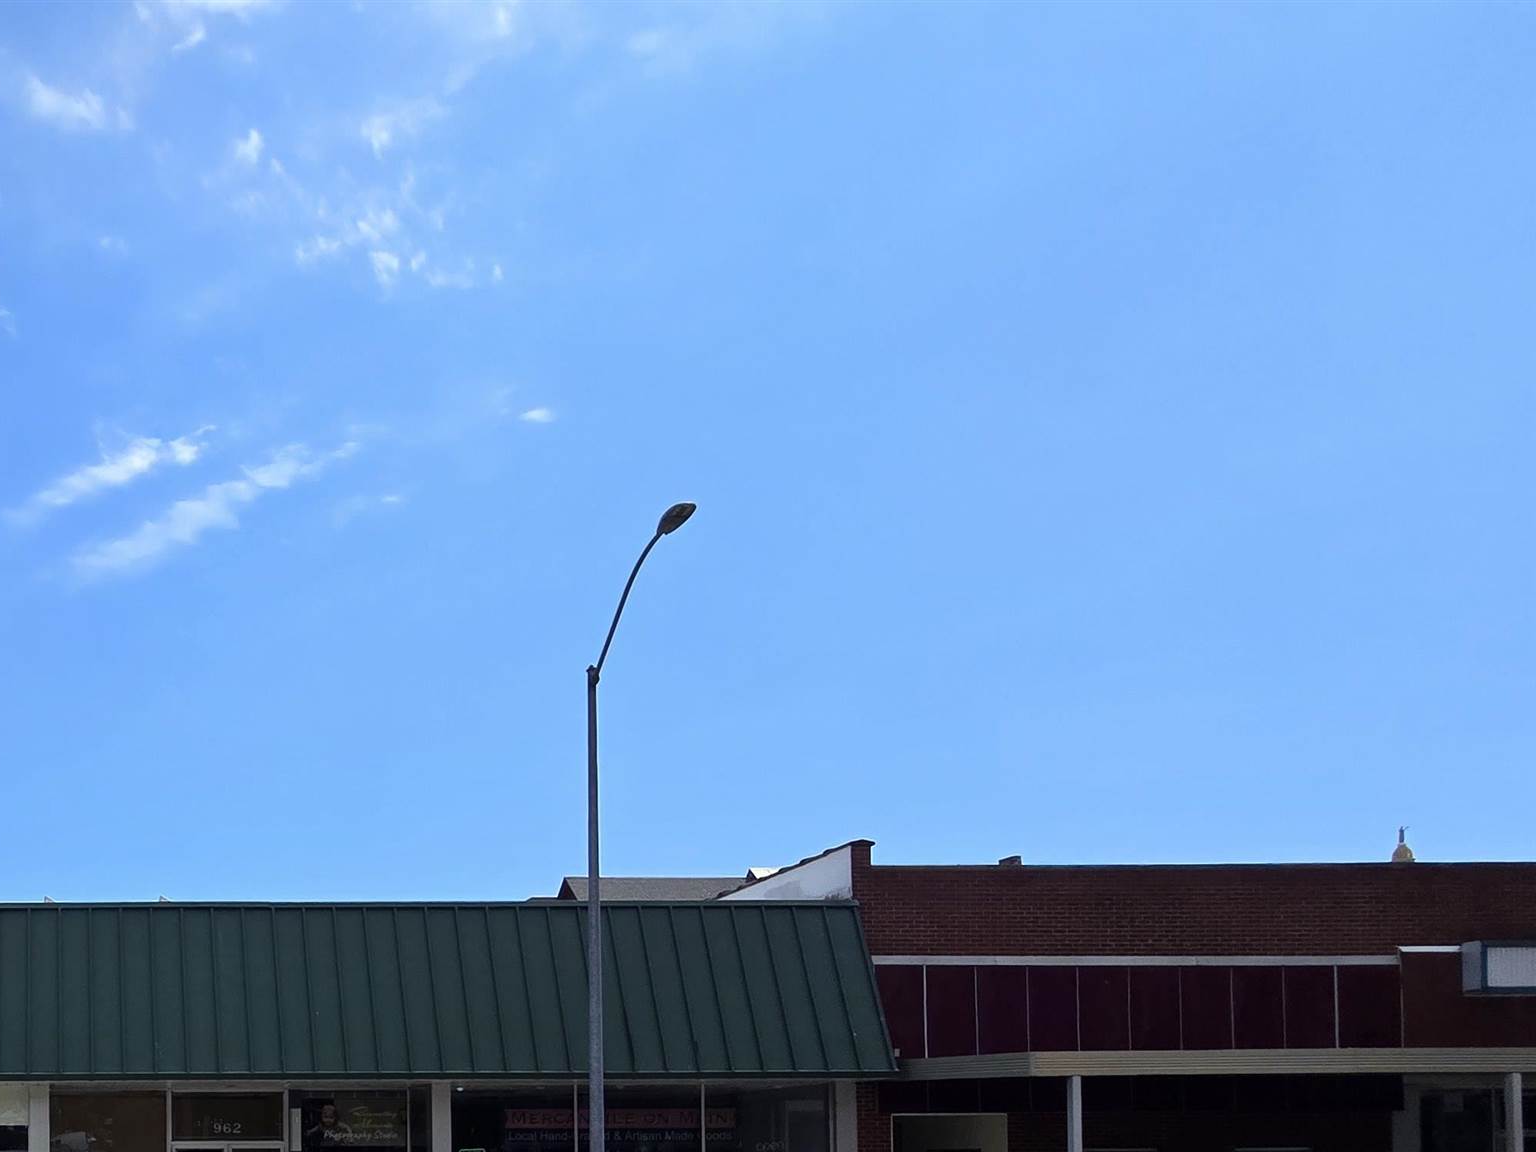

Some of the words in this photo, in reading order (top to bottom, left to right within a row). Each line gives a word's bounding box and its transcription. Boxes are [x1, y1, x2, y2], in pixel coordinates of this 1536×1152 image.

[511, 1111, 631, 1124] MERCANILE
[679, 1111, 728, 1124] MIN
[213, 1122, 241, 1134] 962
[508, 1131, 537, 1142] Local
[624, 1131, 662, 1142] Artisan
[696, 1131, 733, 1142] oods
